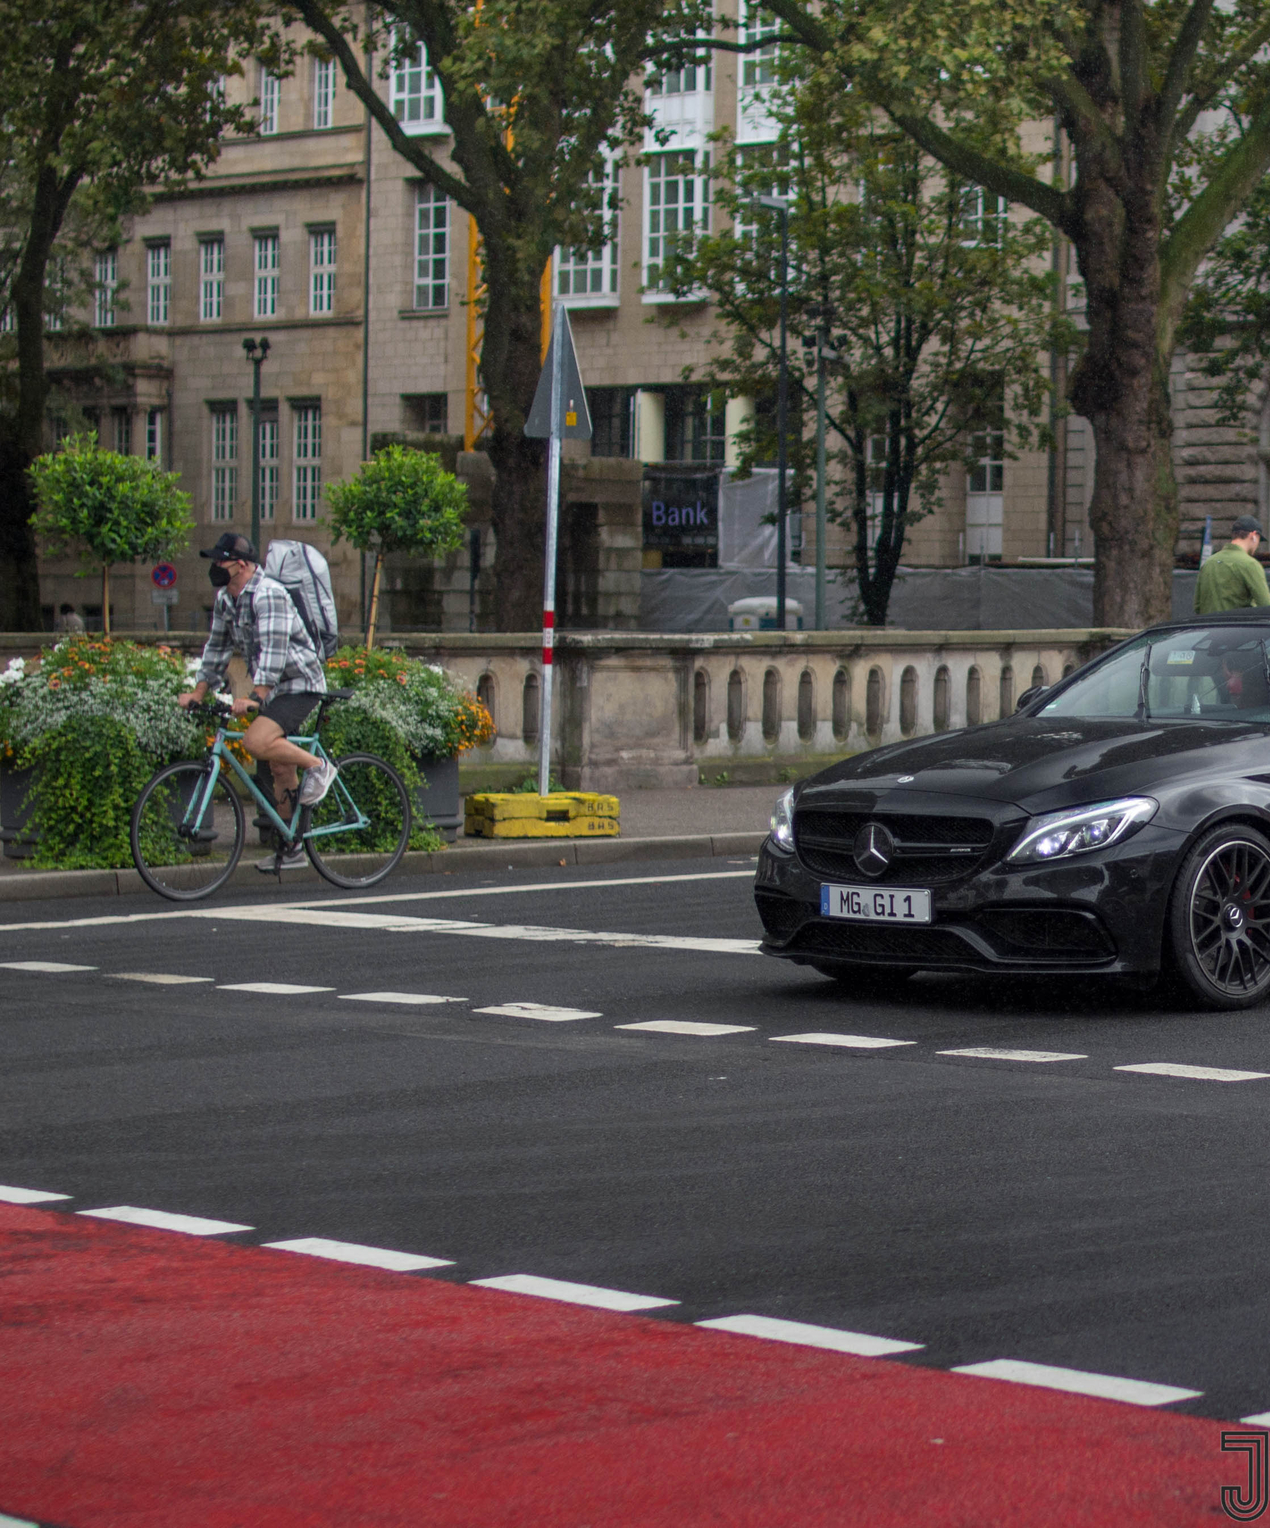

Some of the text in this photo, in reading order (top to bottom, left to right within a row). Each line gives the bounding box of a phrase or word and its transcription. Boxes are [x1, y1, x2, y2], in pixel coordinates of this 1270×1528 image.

[652, 501, 708, 526] Bank
[840, 890, 915, 918] MG GI 1
